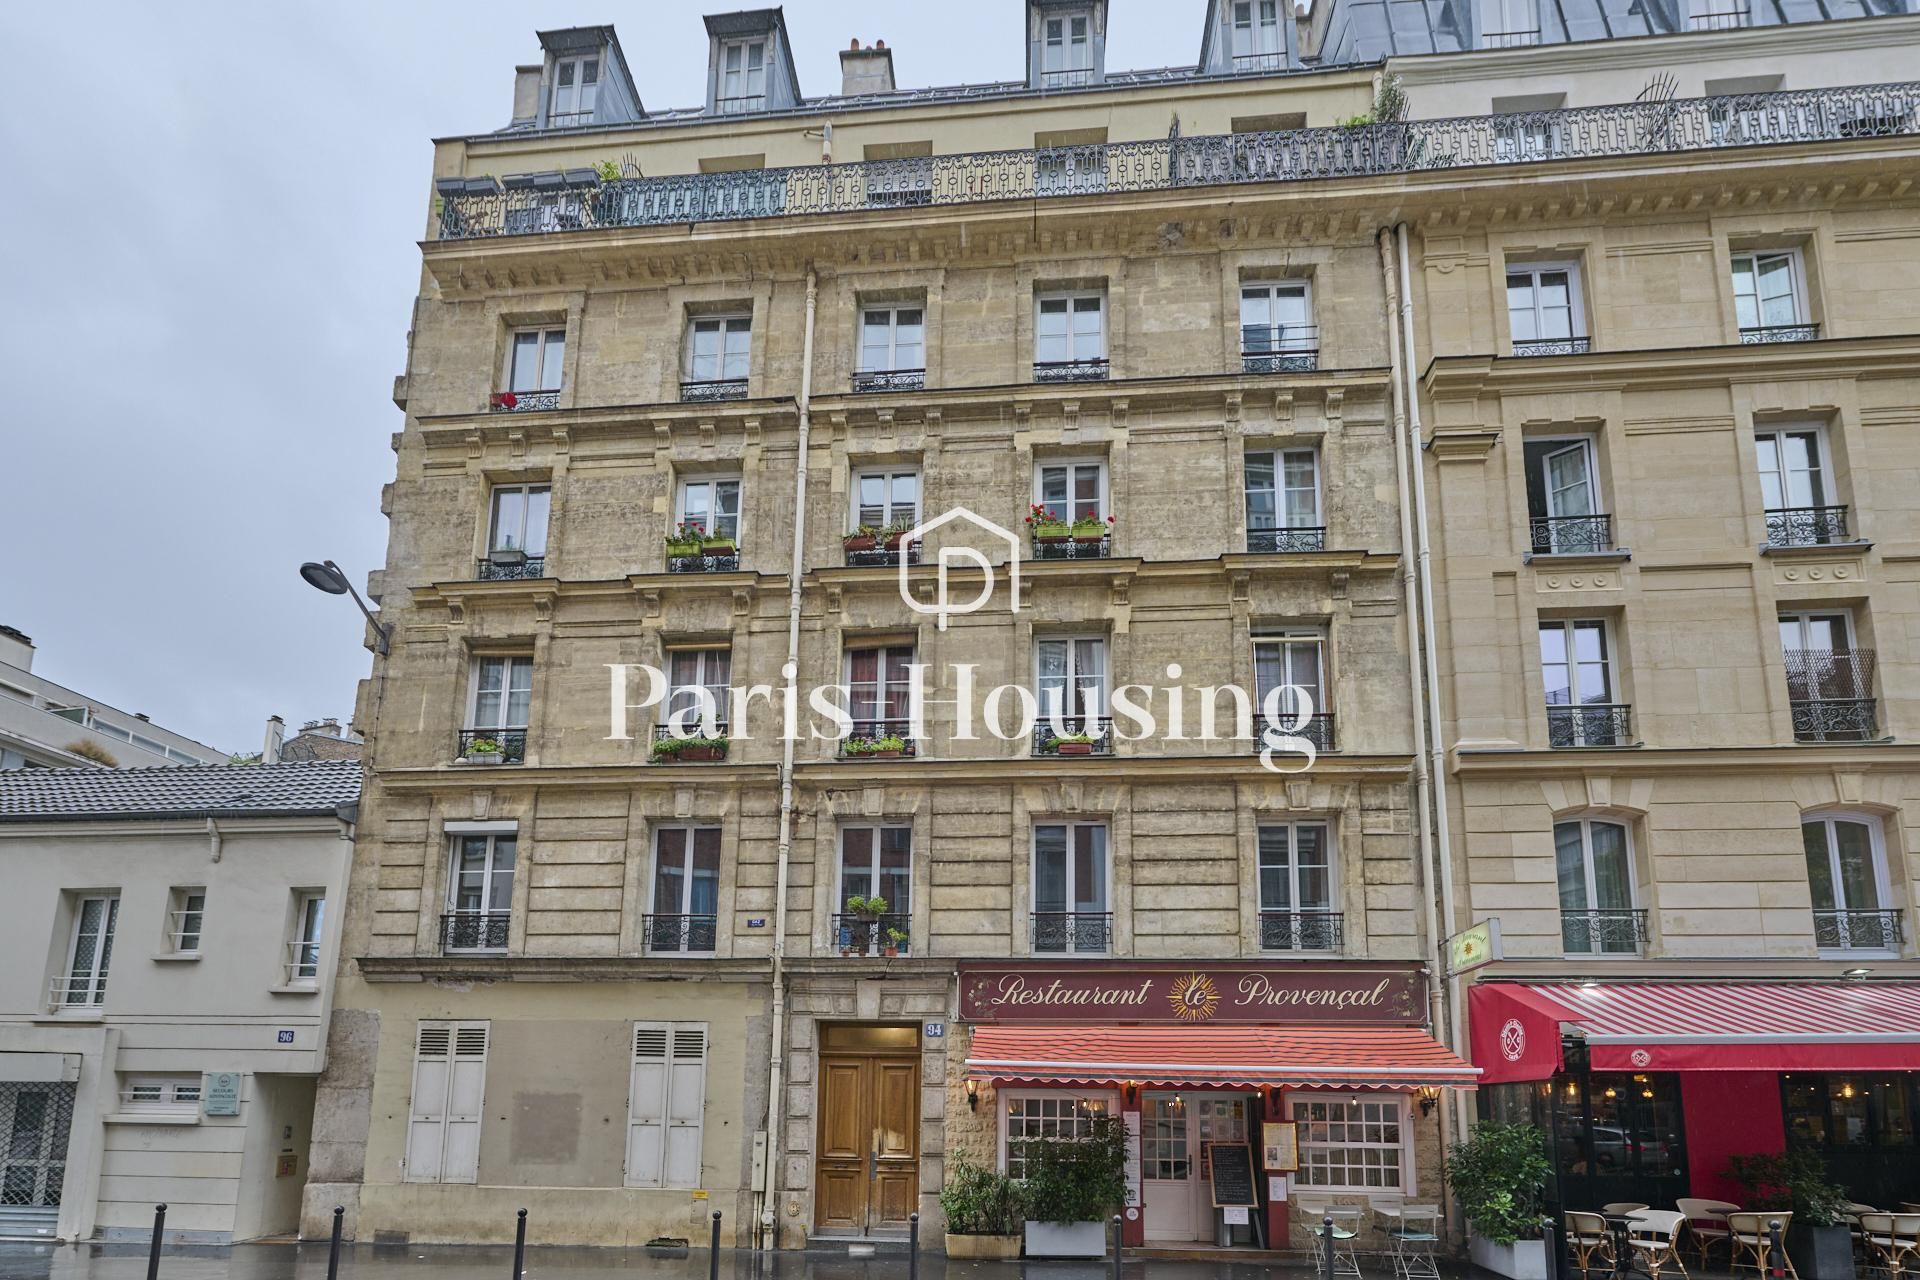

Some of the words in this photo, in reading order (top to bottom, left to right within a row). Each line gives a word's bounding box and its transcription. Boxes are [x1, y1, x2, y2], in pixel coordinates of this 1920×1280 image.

[991, 974, 1154, 1005] Restaurant
[1234, 973, 1390, 1010] Provençal
[928, 1024, 942, 1035] 94
[280, 1031, 292, 1041] 96
